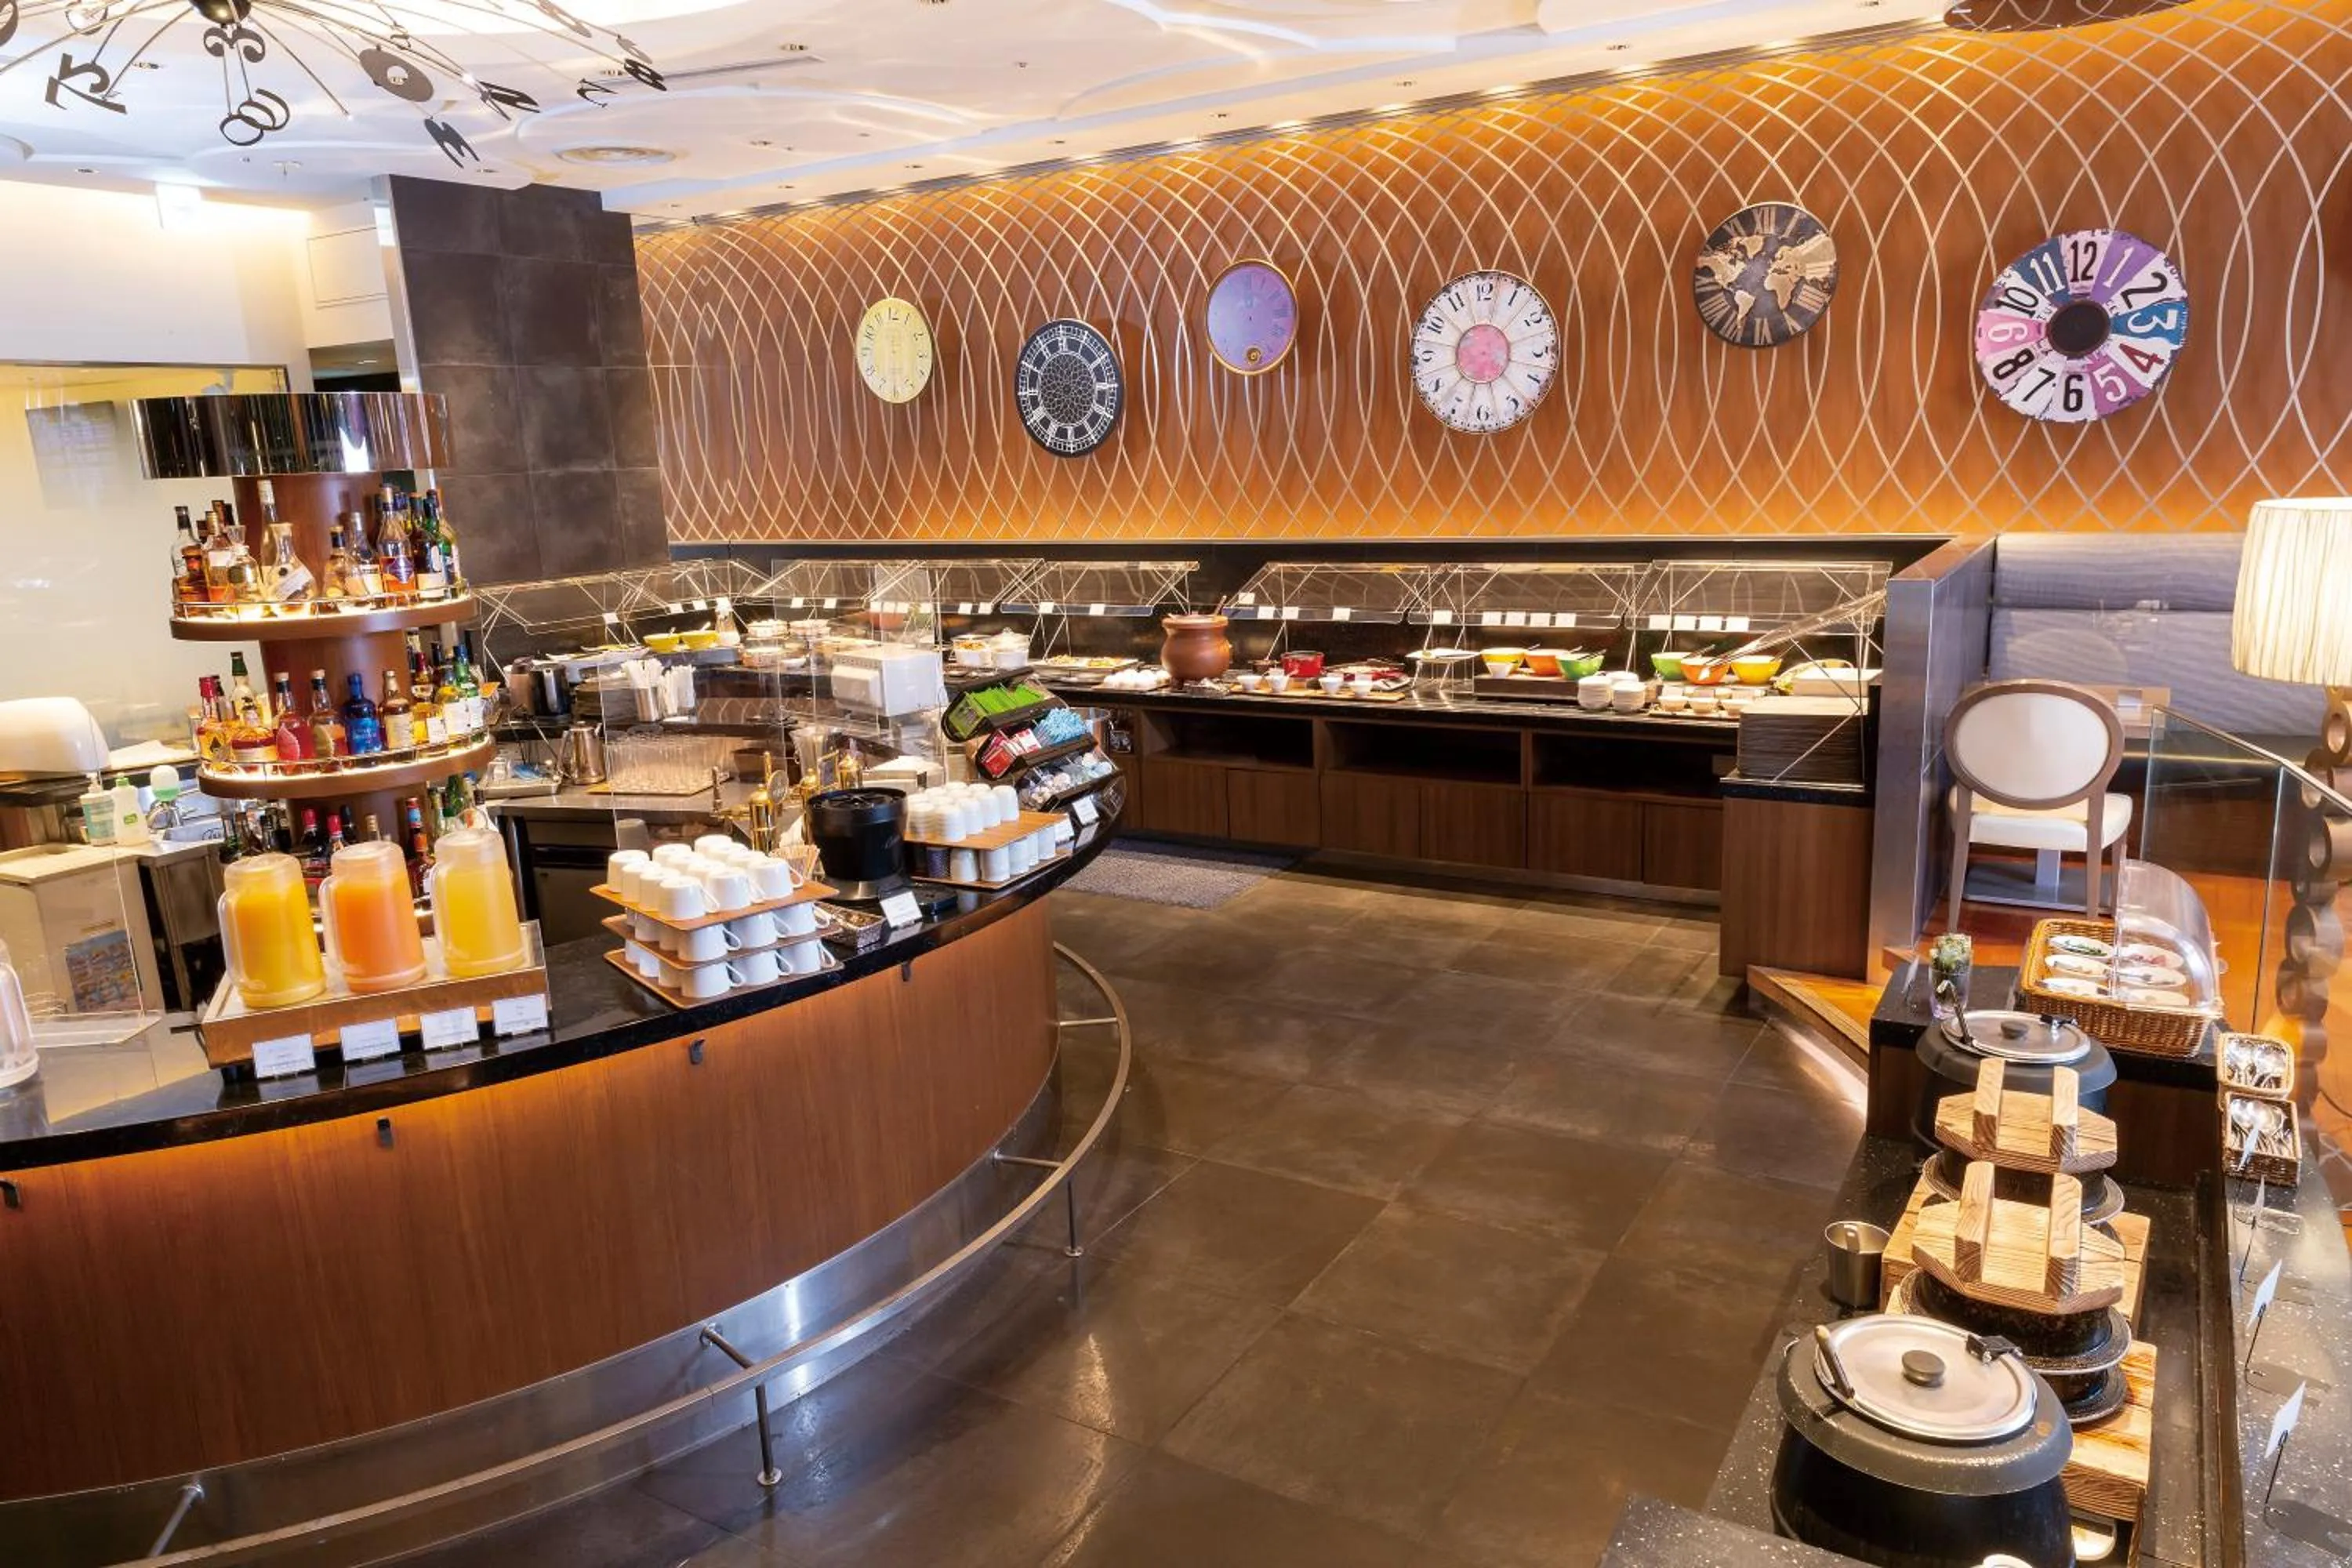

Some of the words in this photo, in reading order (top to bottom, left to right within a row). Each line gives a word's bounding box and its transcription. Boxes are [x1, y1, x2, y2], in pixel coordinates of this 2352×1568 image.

[2030, 251, 2066, 297] 11
[2069, 240, 2098, 283] 12
[2102, 246, 2135, 288] 1
[1448, 292, 1465, 313] 11
[1476, 282, 1494, 302] 12
[1508, 289, 1518, 307] 1
[1994, 285, 2039, 318] 10
[2121, 271, 2169, 310] 2
[1987, 321, 2029, 343] 9
[2127, 309, 2178, 334] 3
[1992, 347, 2035, 381] 8
[2118, 342, 2165, 375] 4
[2022, 367, 2056, 402] 7
[2063, 374, 2084, 413] 6
[2093, 362, 2128, 402] 5
